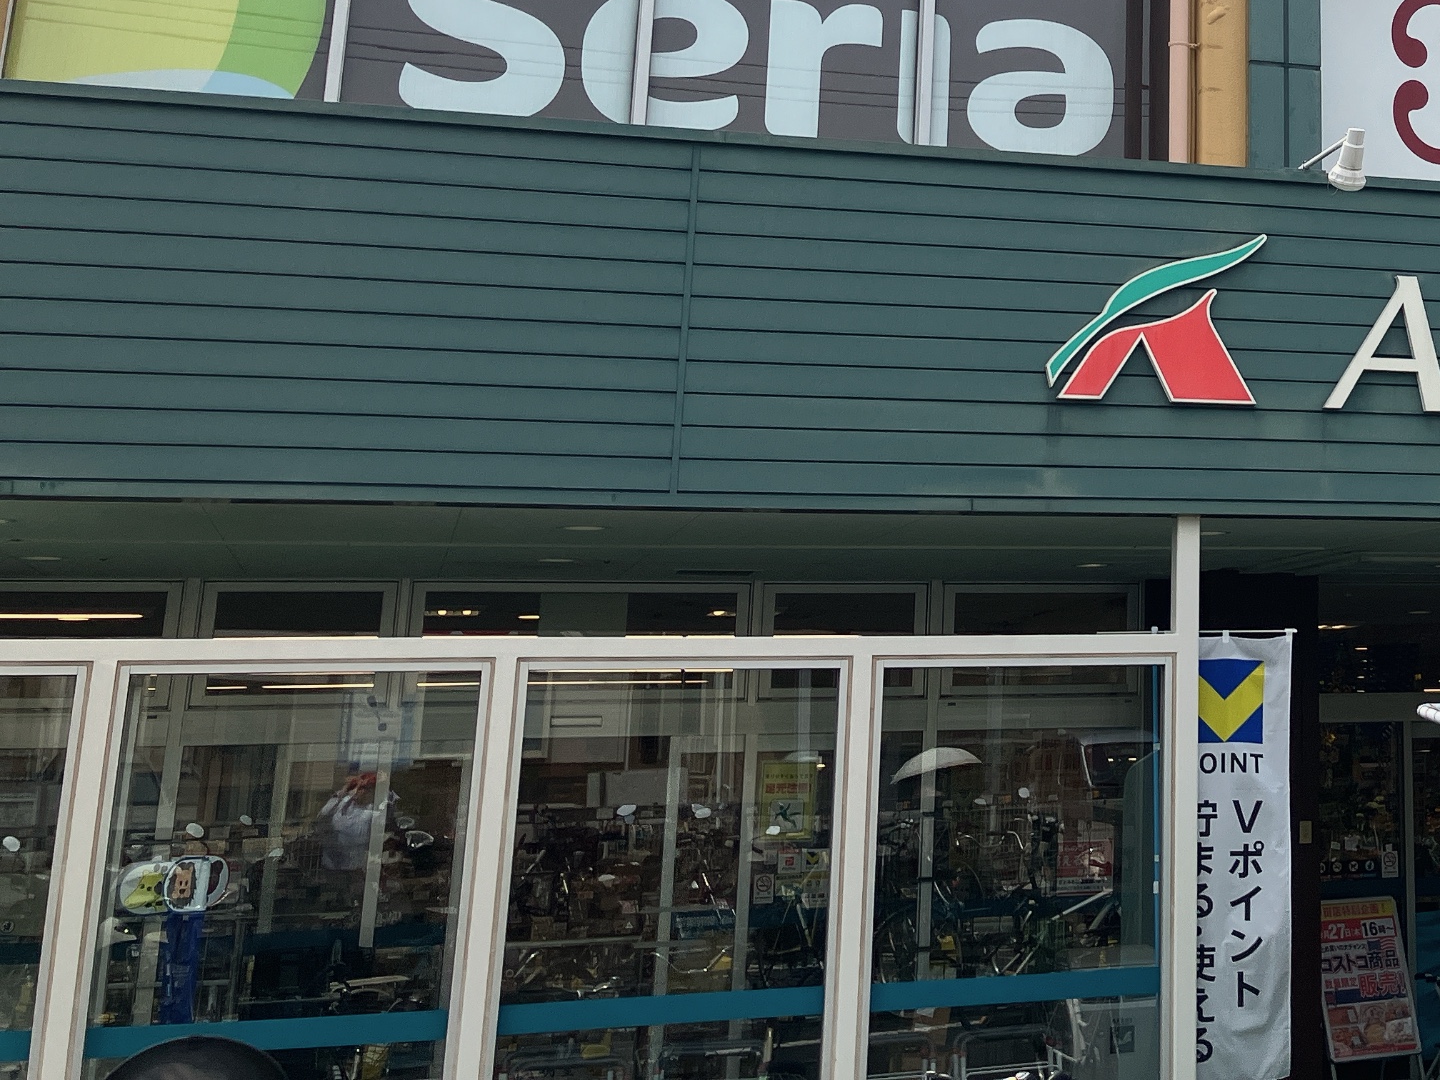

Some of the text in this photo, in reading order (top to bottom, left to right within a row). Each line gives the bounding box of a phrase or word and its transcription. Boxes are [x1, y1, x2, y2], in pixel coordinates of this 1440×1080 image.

[1199, 752, 1264, 774] OINT
[1228, 799, 1265, 1008] Vポイント
